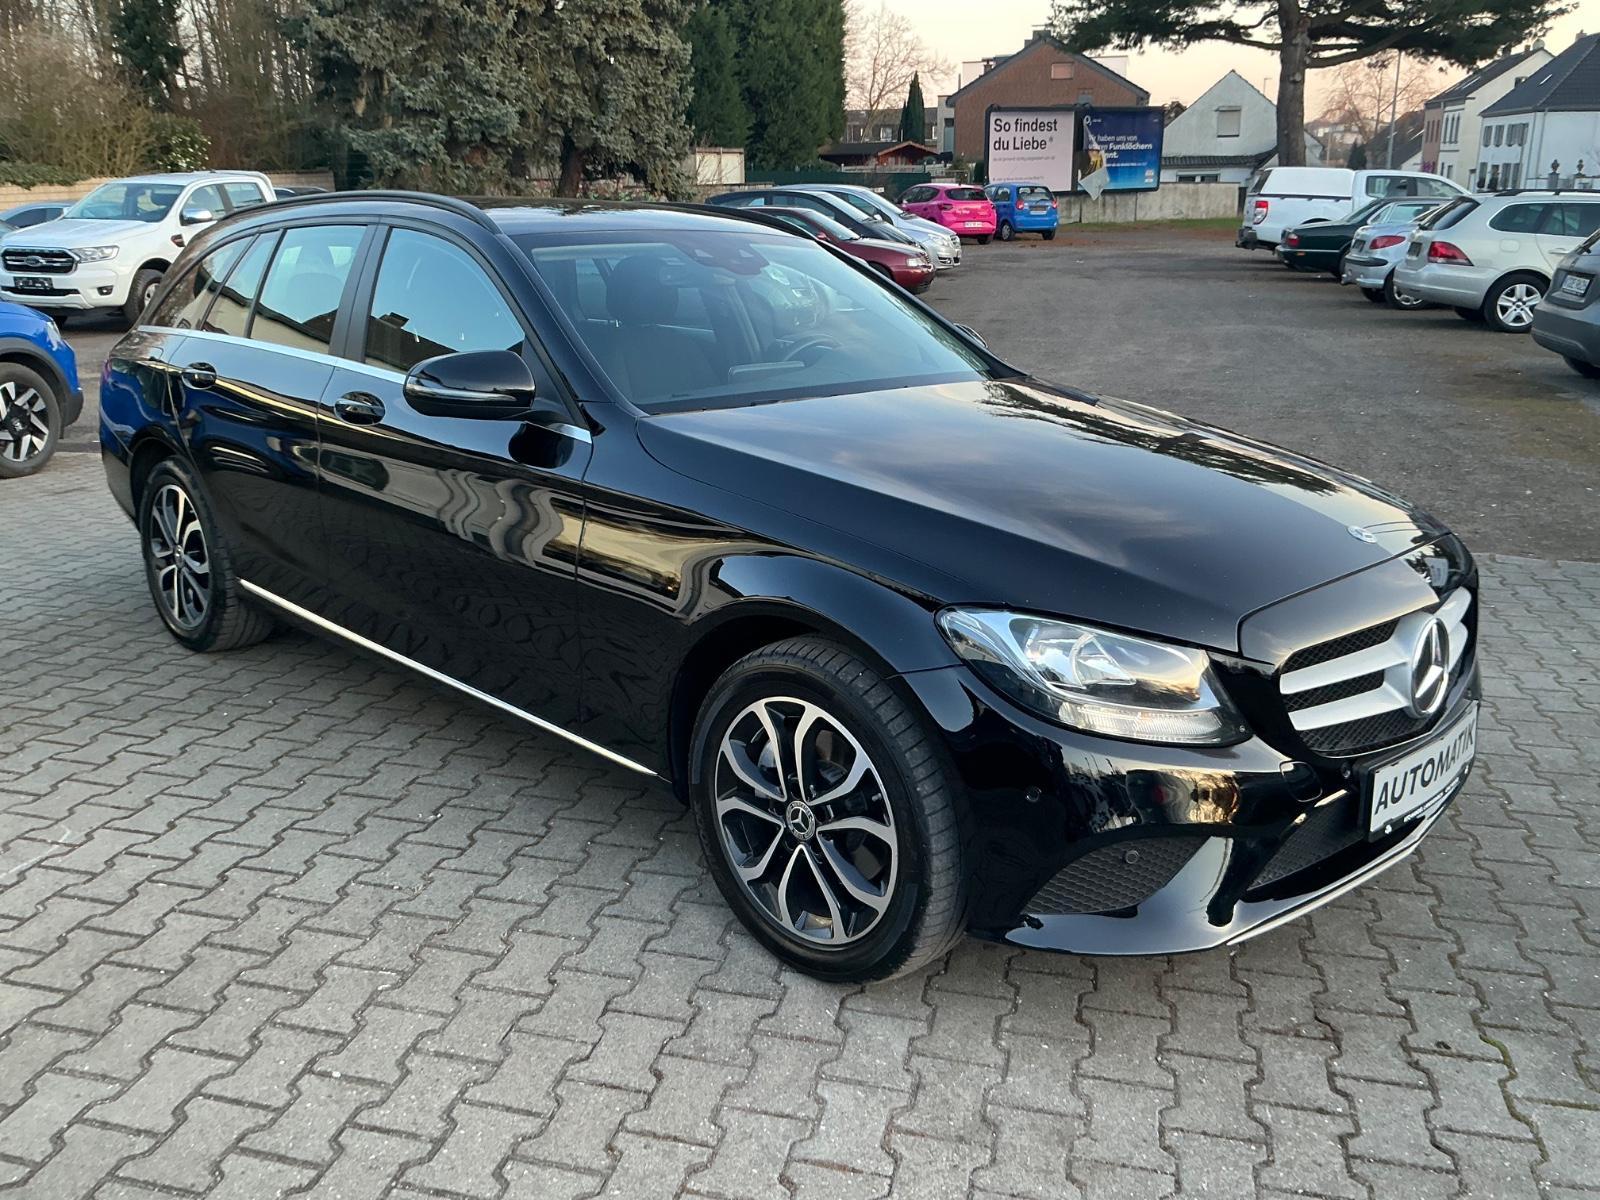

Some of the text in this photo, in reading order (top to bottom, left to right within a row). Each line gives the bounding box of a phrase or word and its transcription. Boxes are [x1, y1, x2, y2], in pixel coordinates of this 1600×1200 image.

[994, 118, 1058, 132] So findest
[993, 136, 1047, 151] du Liebe
[1109, 142, 1153, 151] Funklöchern
[1374, 718, 1475, 815] AUTOMATIK
